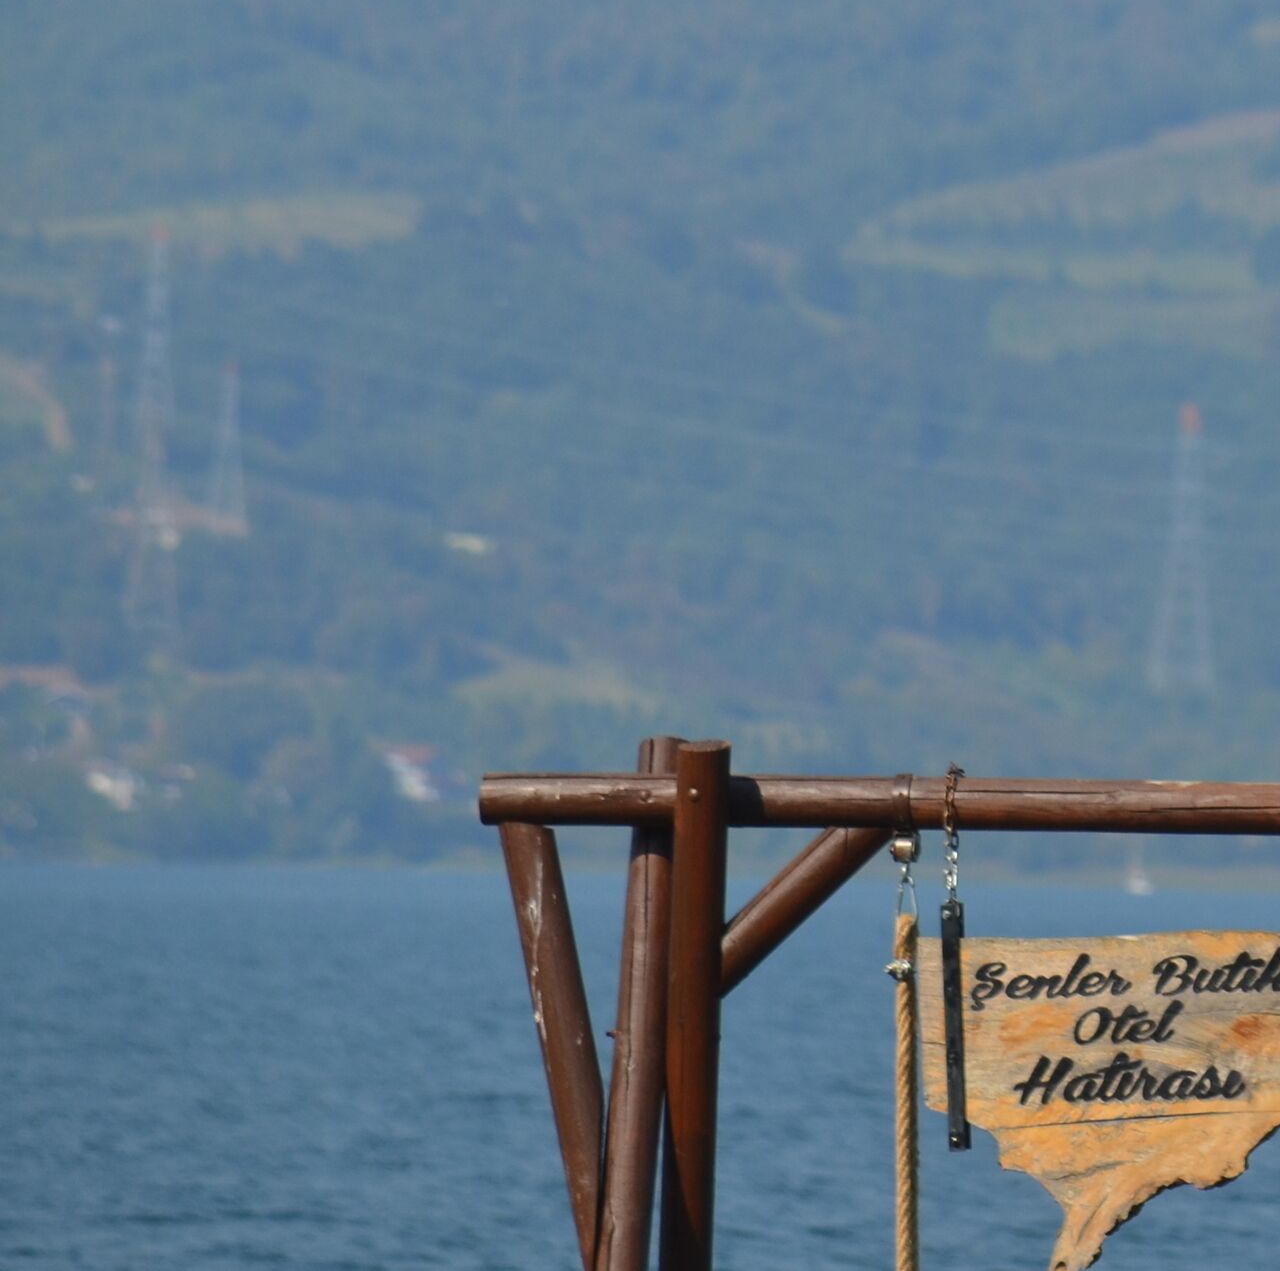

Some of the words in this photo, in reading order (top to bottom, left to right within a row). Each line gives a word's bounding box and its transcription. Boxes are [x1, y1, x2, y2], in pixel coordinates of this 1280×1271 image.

[970, 953, 1132, 1011] Şenler
[1074, 1000, 1184, 1045] Otel
[1013, 1051, 1246, 1105] Hatırası
